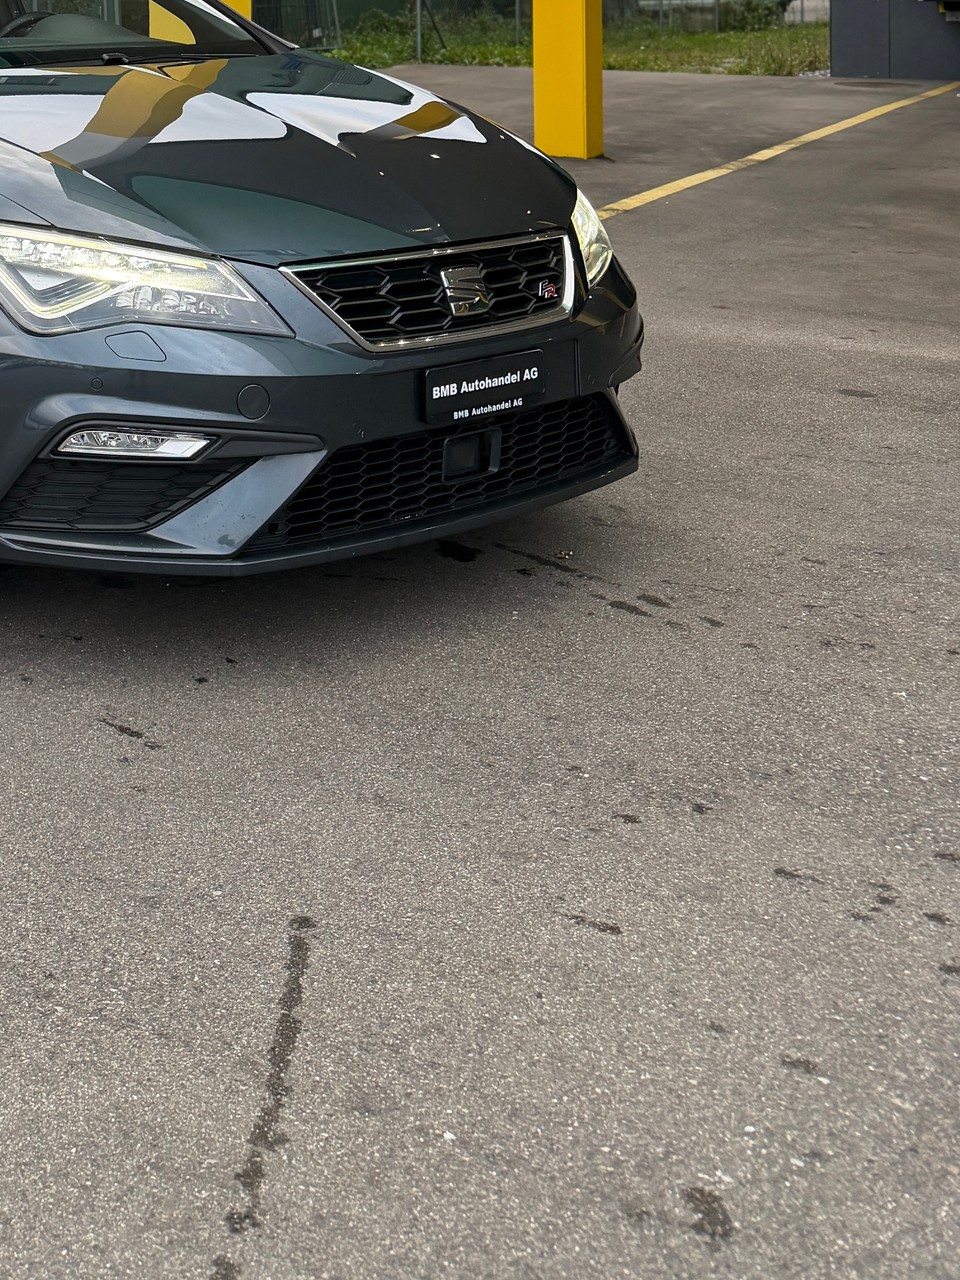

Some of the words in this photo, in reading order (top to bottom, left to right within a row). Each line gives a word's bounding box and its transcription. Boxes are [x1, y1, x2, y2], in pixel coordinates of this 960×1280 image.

[538, 279, 558, 299] FR
[432, 383, 458, 399] BMB
[460, 370, 521, 394] Autohandel
[523, 367, 539, 381] AG
[453, 409, 470, 420] BMB
[471, 399, 512, 416] Autohandel
[513, 398, 523, 407] AG
